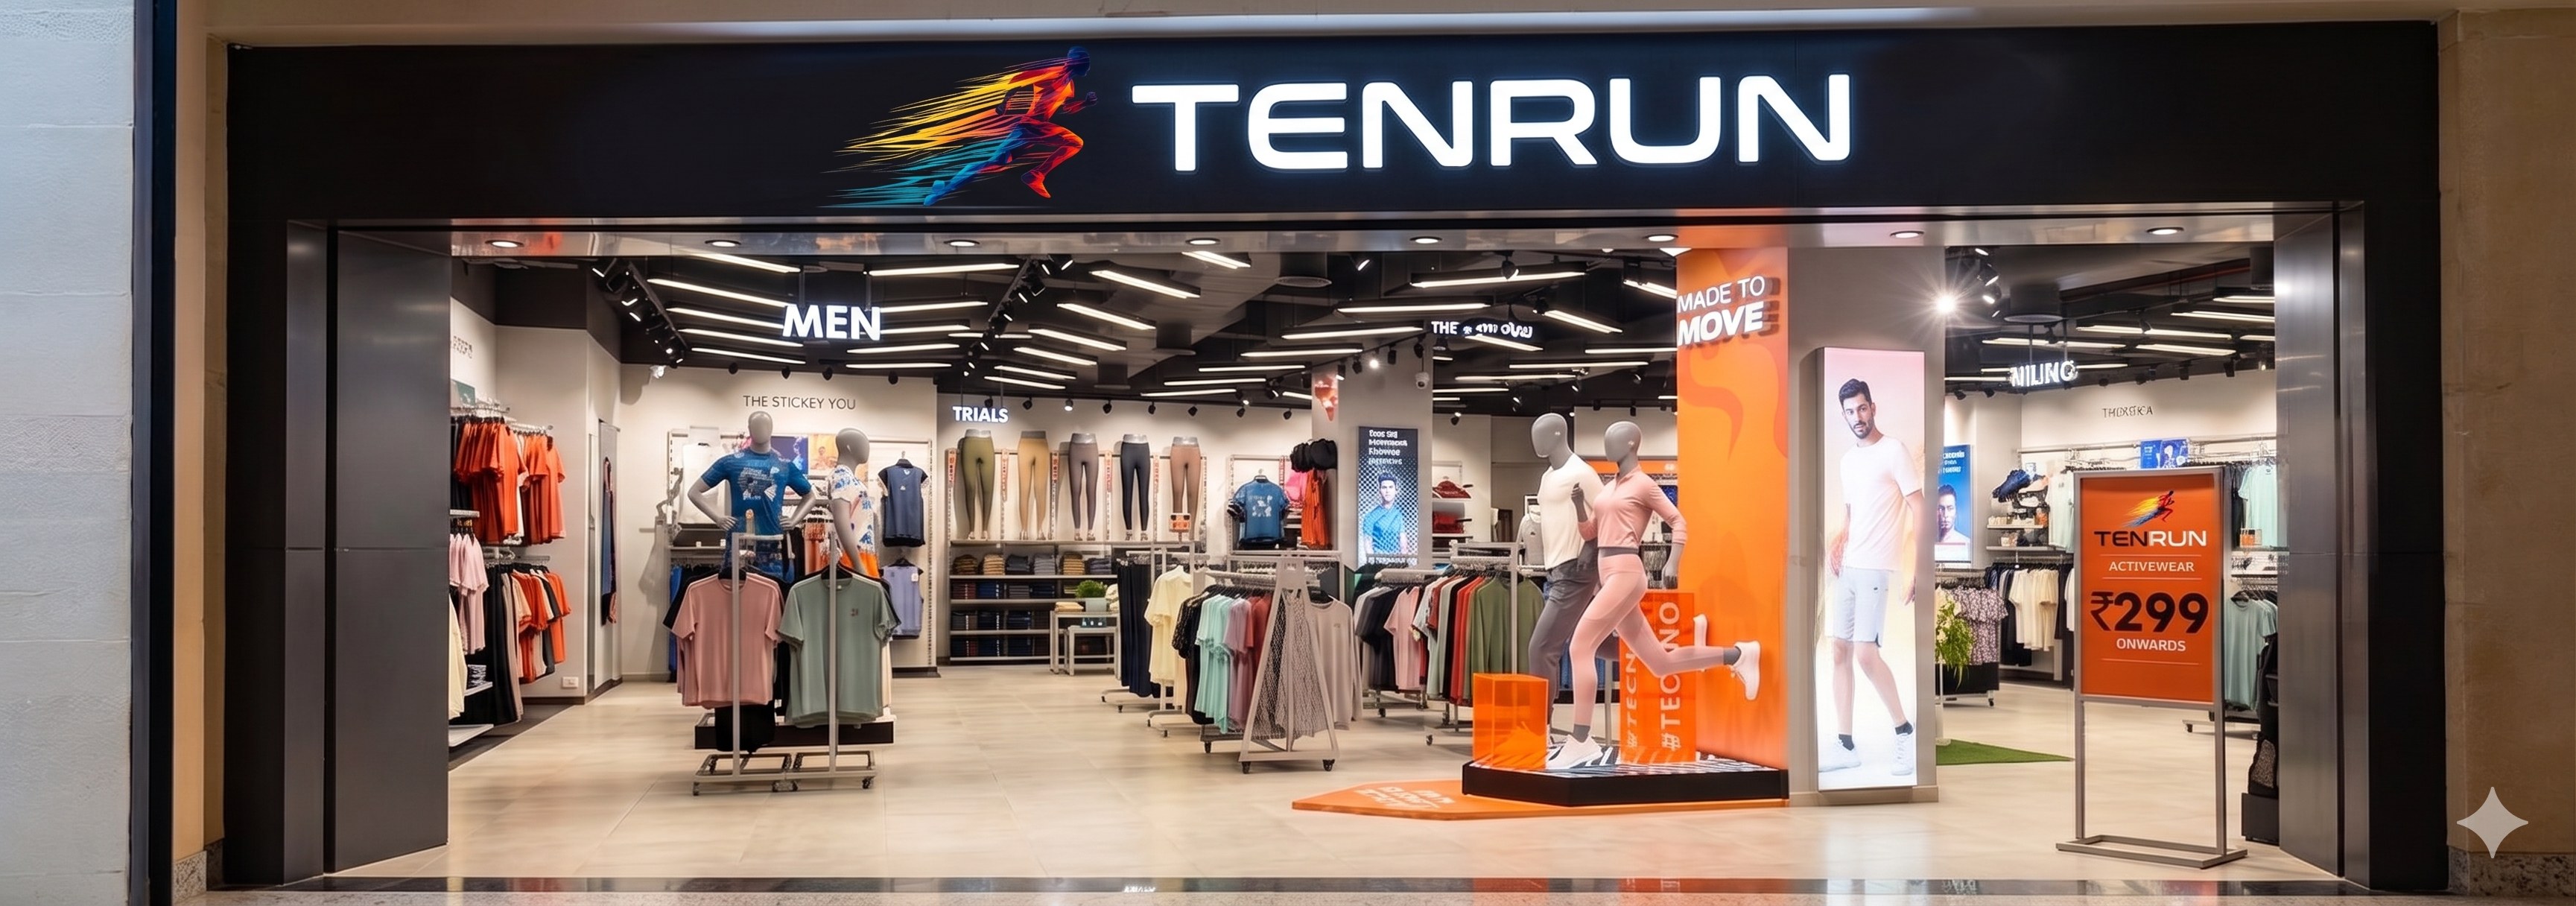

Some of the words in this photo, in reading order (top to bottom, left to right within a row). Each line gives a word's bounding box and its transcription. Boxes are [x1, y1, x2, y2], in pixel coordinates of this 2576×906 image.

[1131, 73, 1851, 172] TENRUN
[1677, 282, 1732, 313] MADE
[1737, 276, 1766, 299] TO
[782, 303, 881, 340] MEN
[1431, 320, 1460, 335] THE
[1677, 301, 1765, 346] MOVE
[743, 395, 768, 407] THE
[772, 396, 825, 409] STICKEY
[828, 397, 856, 410] YOU
[952, 406, 1009, 423] TRIALS
[2093, 530, 2207, 548] TENRUN
[2108, 560, 2195, 572] ACTIVEWEAR
[2090, 591, 2209, 634] ₹299
[2116, 638, 2186, 652] ONWARDS
[1659, 601, 1681, 752] #TECNO
